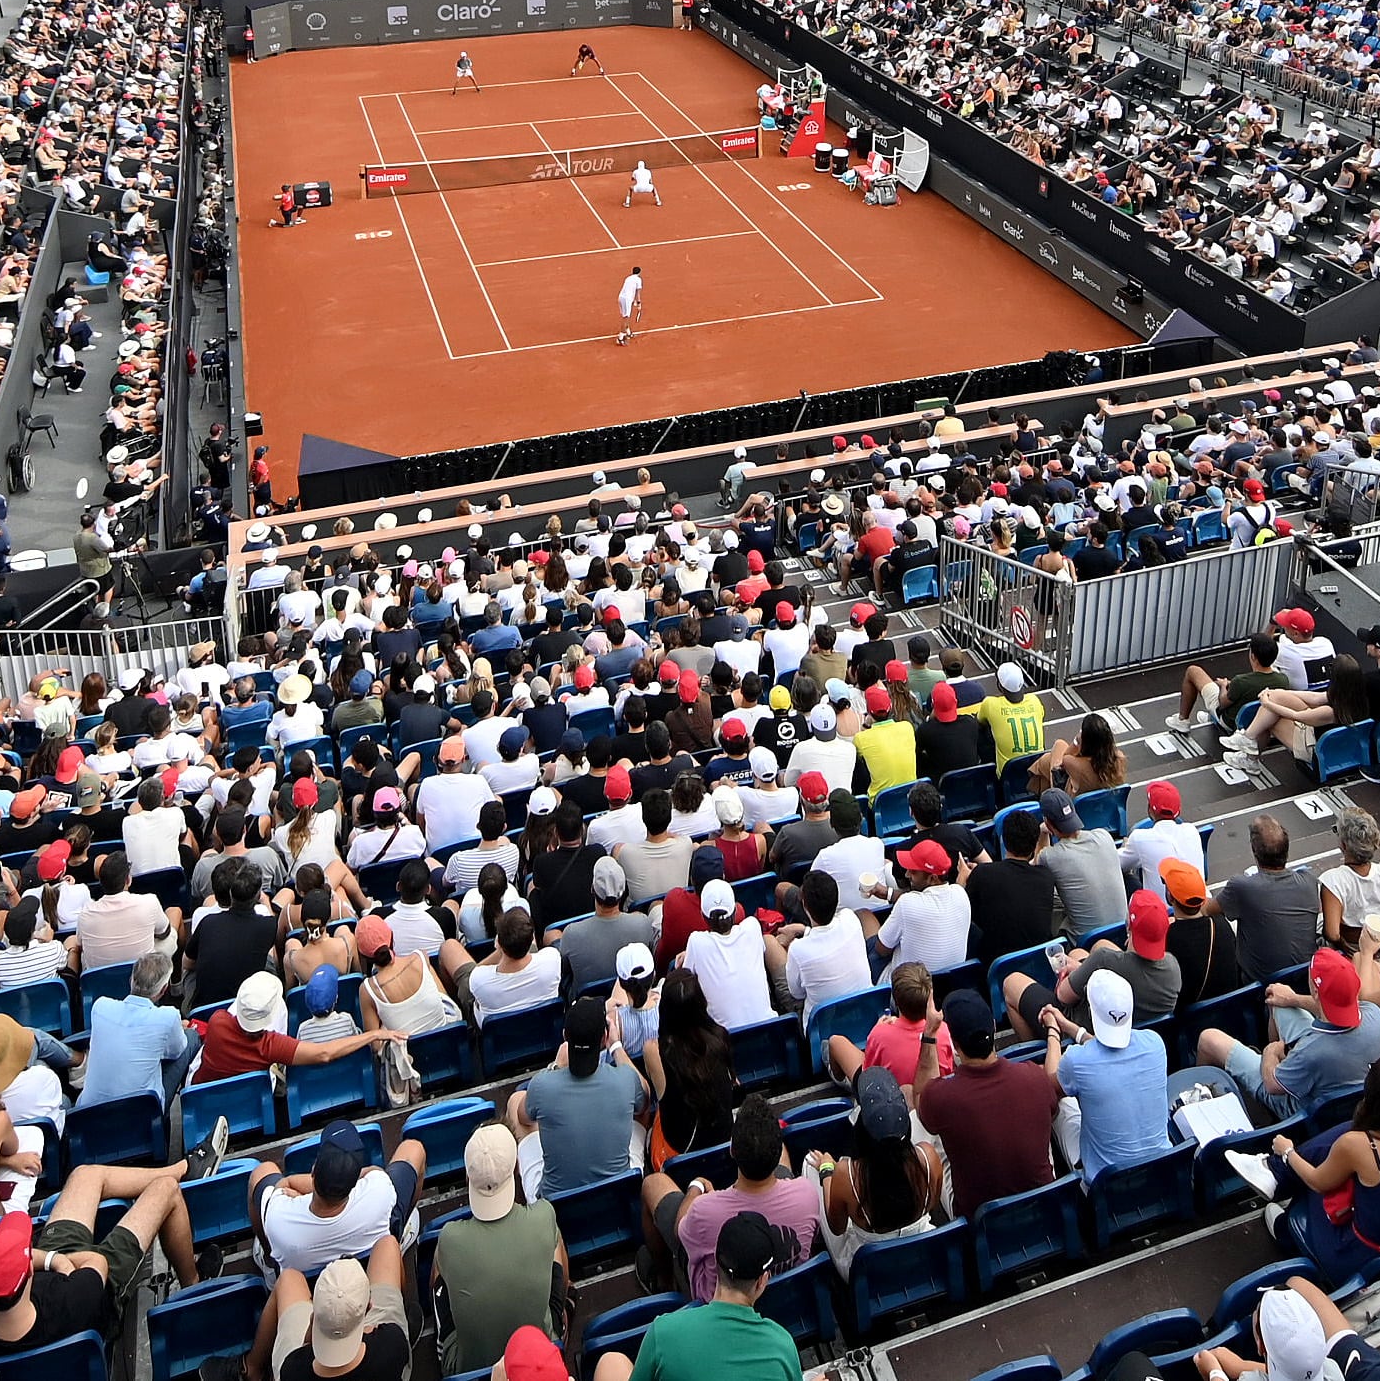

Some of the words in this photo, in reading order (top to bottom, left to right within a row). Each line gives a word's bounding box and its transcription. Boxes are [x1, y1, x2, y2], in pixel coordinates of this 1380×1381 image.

[437, 3, 492, 21] Claro
[722, 136, 756, 148] Emirates
[530, 162, 569, 180] ATP
[571, 157, 615, 174] TOUR
[369, 173, 407, 183] Emirates
[776, 182, 812, 192] RIO
[1071, 200, 1097, 222] MAGNUM
[354, 229, 393, 241] RIO
[1002, 221, 1021, 240] Claro
[1109, 219, 1132, 241] ibmec
[1006, 716, 1039, 753] 10
[1224, 768, 1235, 780] J
[1304, 800, 1324, 814] K
